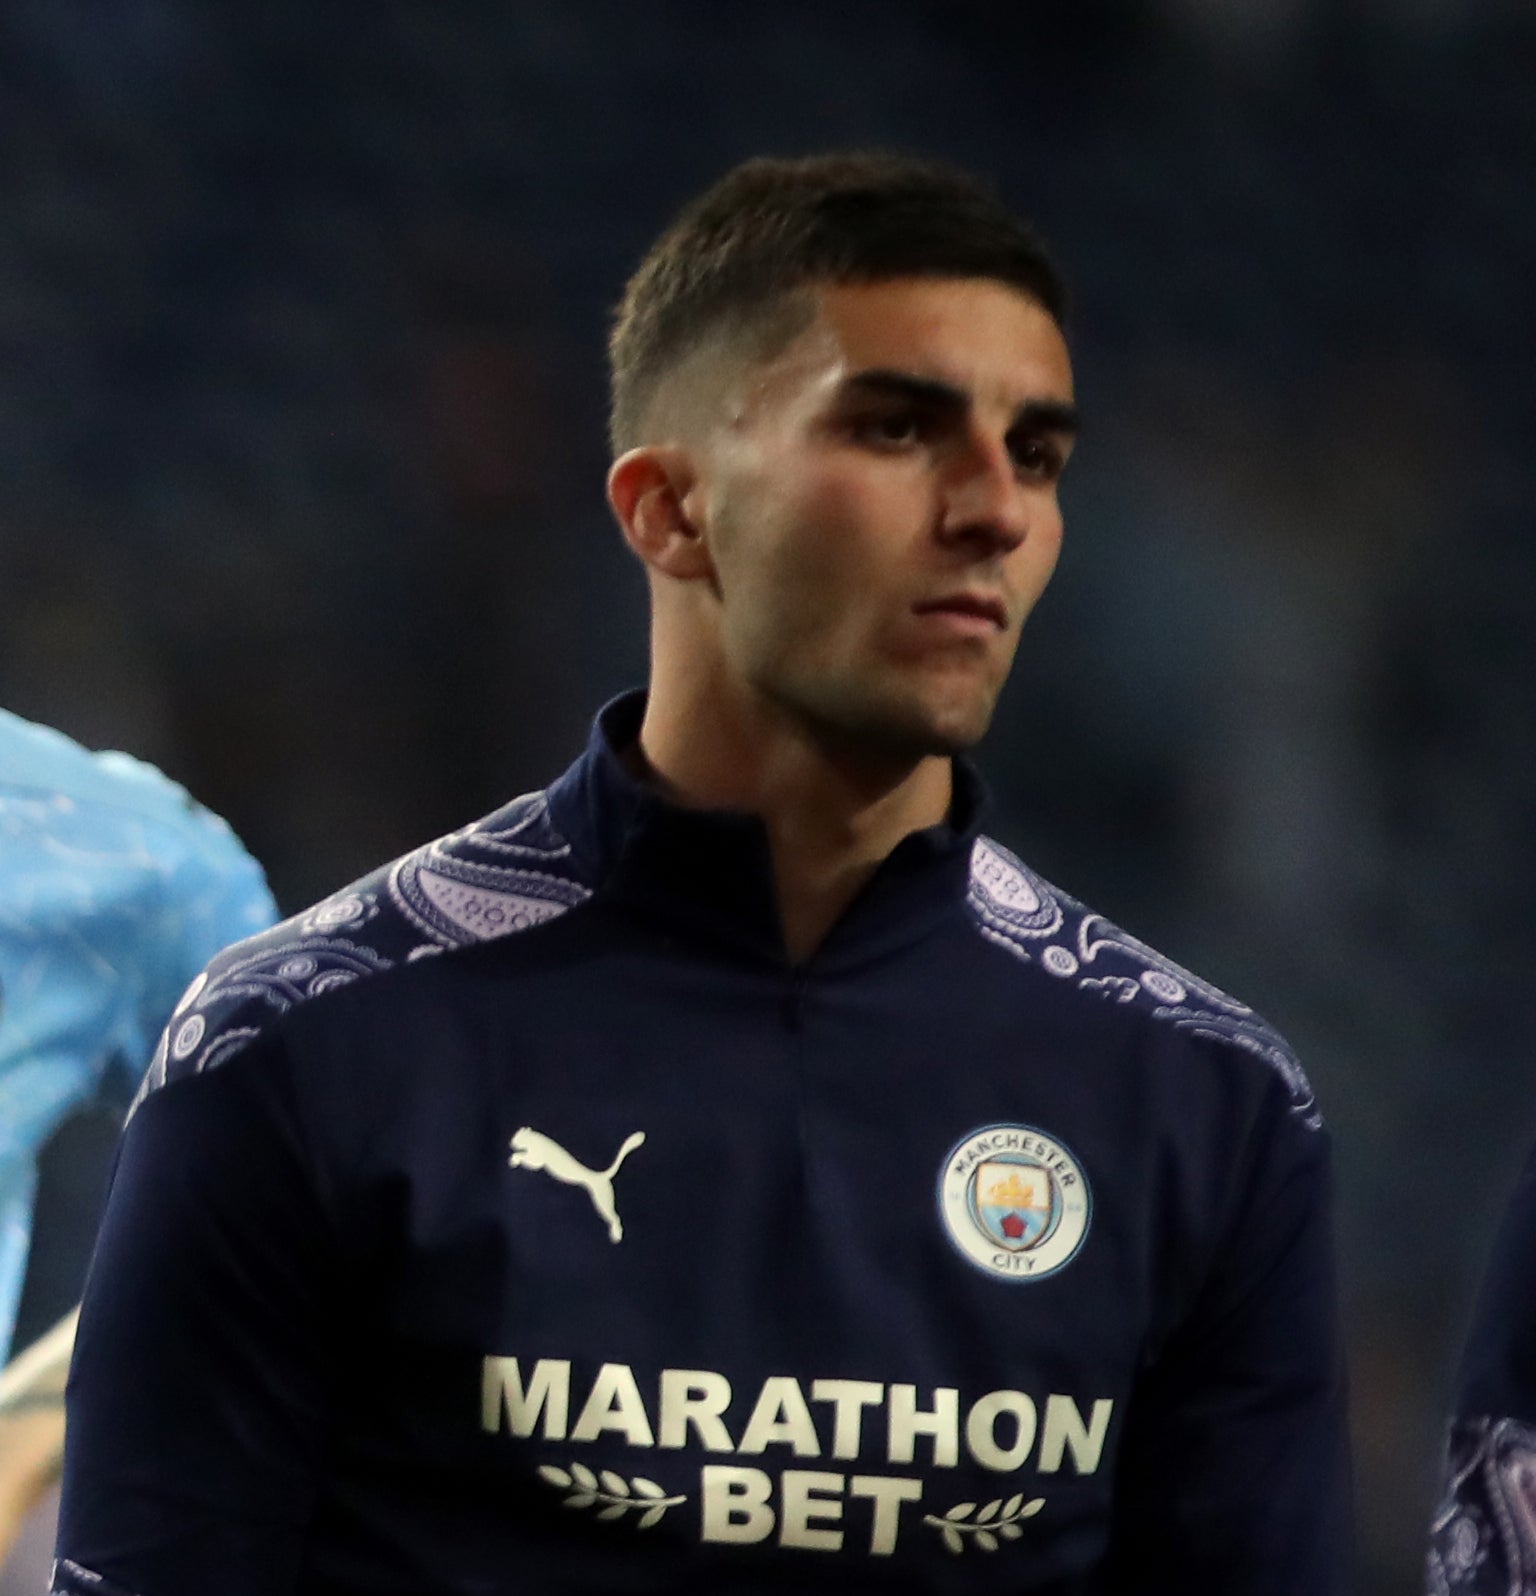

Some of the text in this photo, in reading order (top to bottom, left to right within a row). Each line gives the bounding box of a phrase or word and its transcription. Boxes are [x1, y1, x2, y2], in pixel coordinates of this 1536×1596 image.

[954, 1133, 1077, 1187] MANCHESTER
[992, 1253, 1037, 1270] CITY
[481, 1353, 1114, 1475] MARATHON
[701, 1463, 923, 1557] BET
